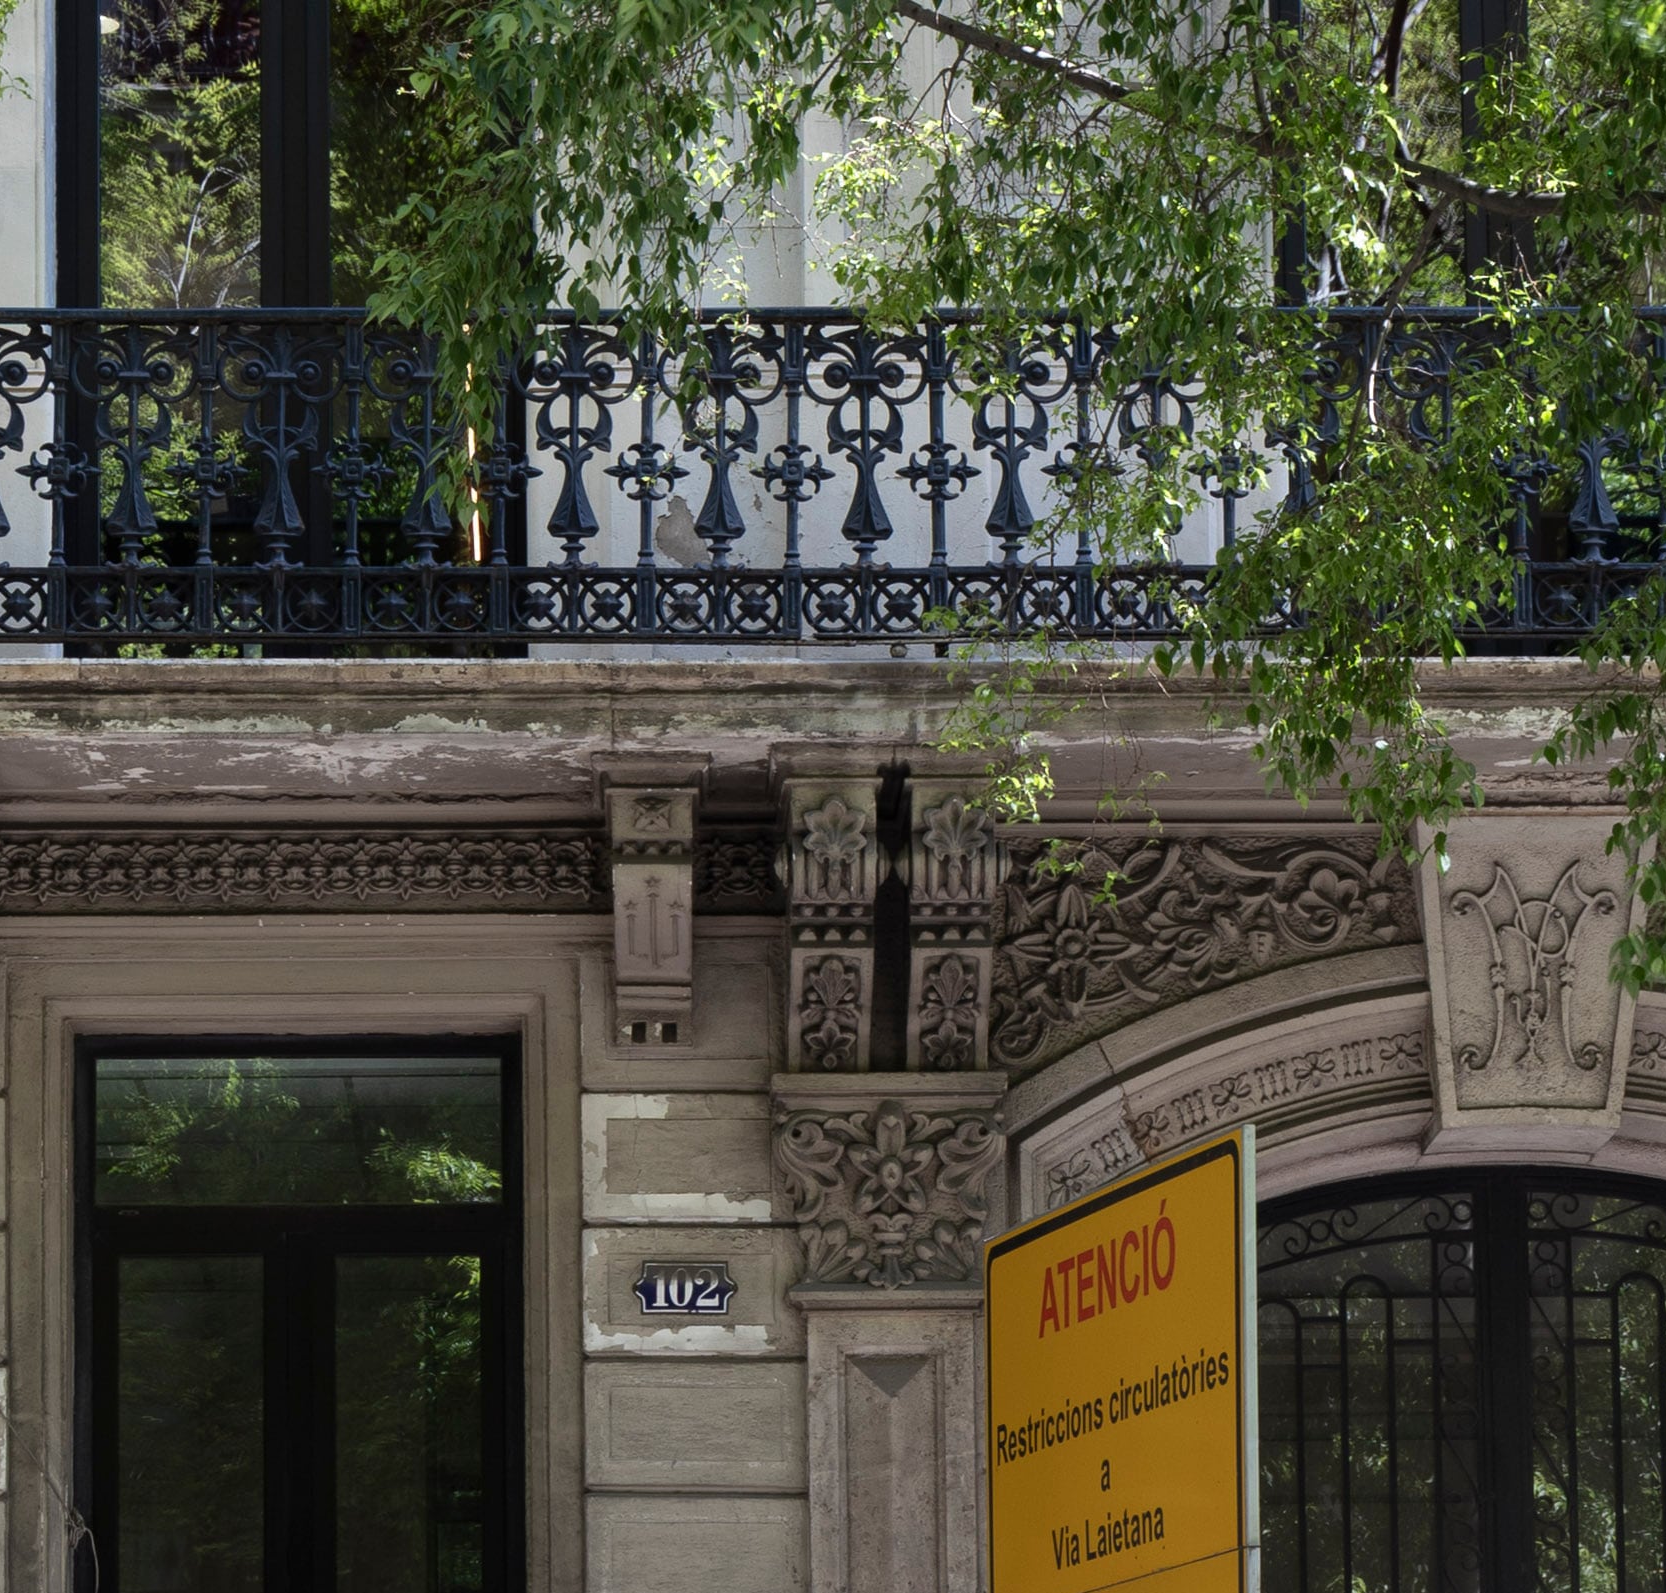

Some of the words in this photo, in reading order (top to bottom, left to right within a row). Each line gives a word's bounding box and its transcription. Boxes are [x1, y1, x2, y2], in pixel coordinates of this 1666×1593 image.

[652, 1267, 720, 1307] 102
[1039, 1199, 1176, 1338] ATENCIÓ
[996, 1399, 1103, 1466] Restriccions
[1109, 1348, 1229, 1425] circulatòries
[1100, 1458, 1111, 1492] a
[1052, 1512, 1081, 1570] Via
[1085, 1507, 1165, 1562] Laietana
